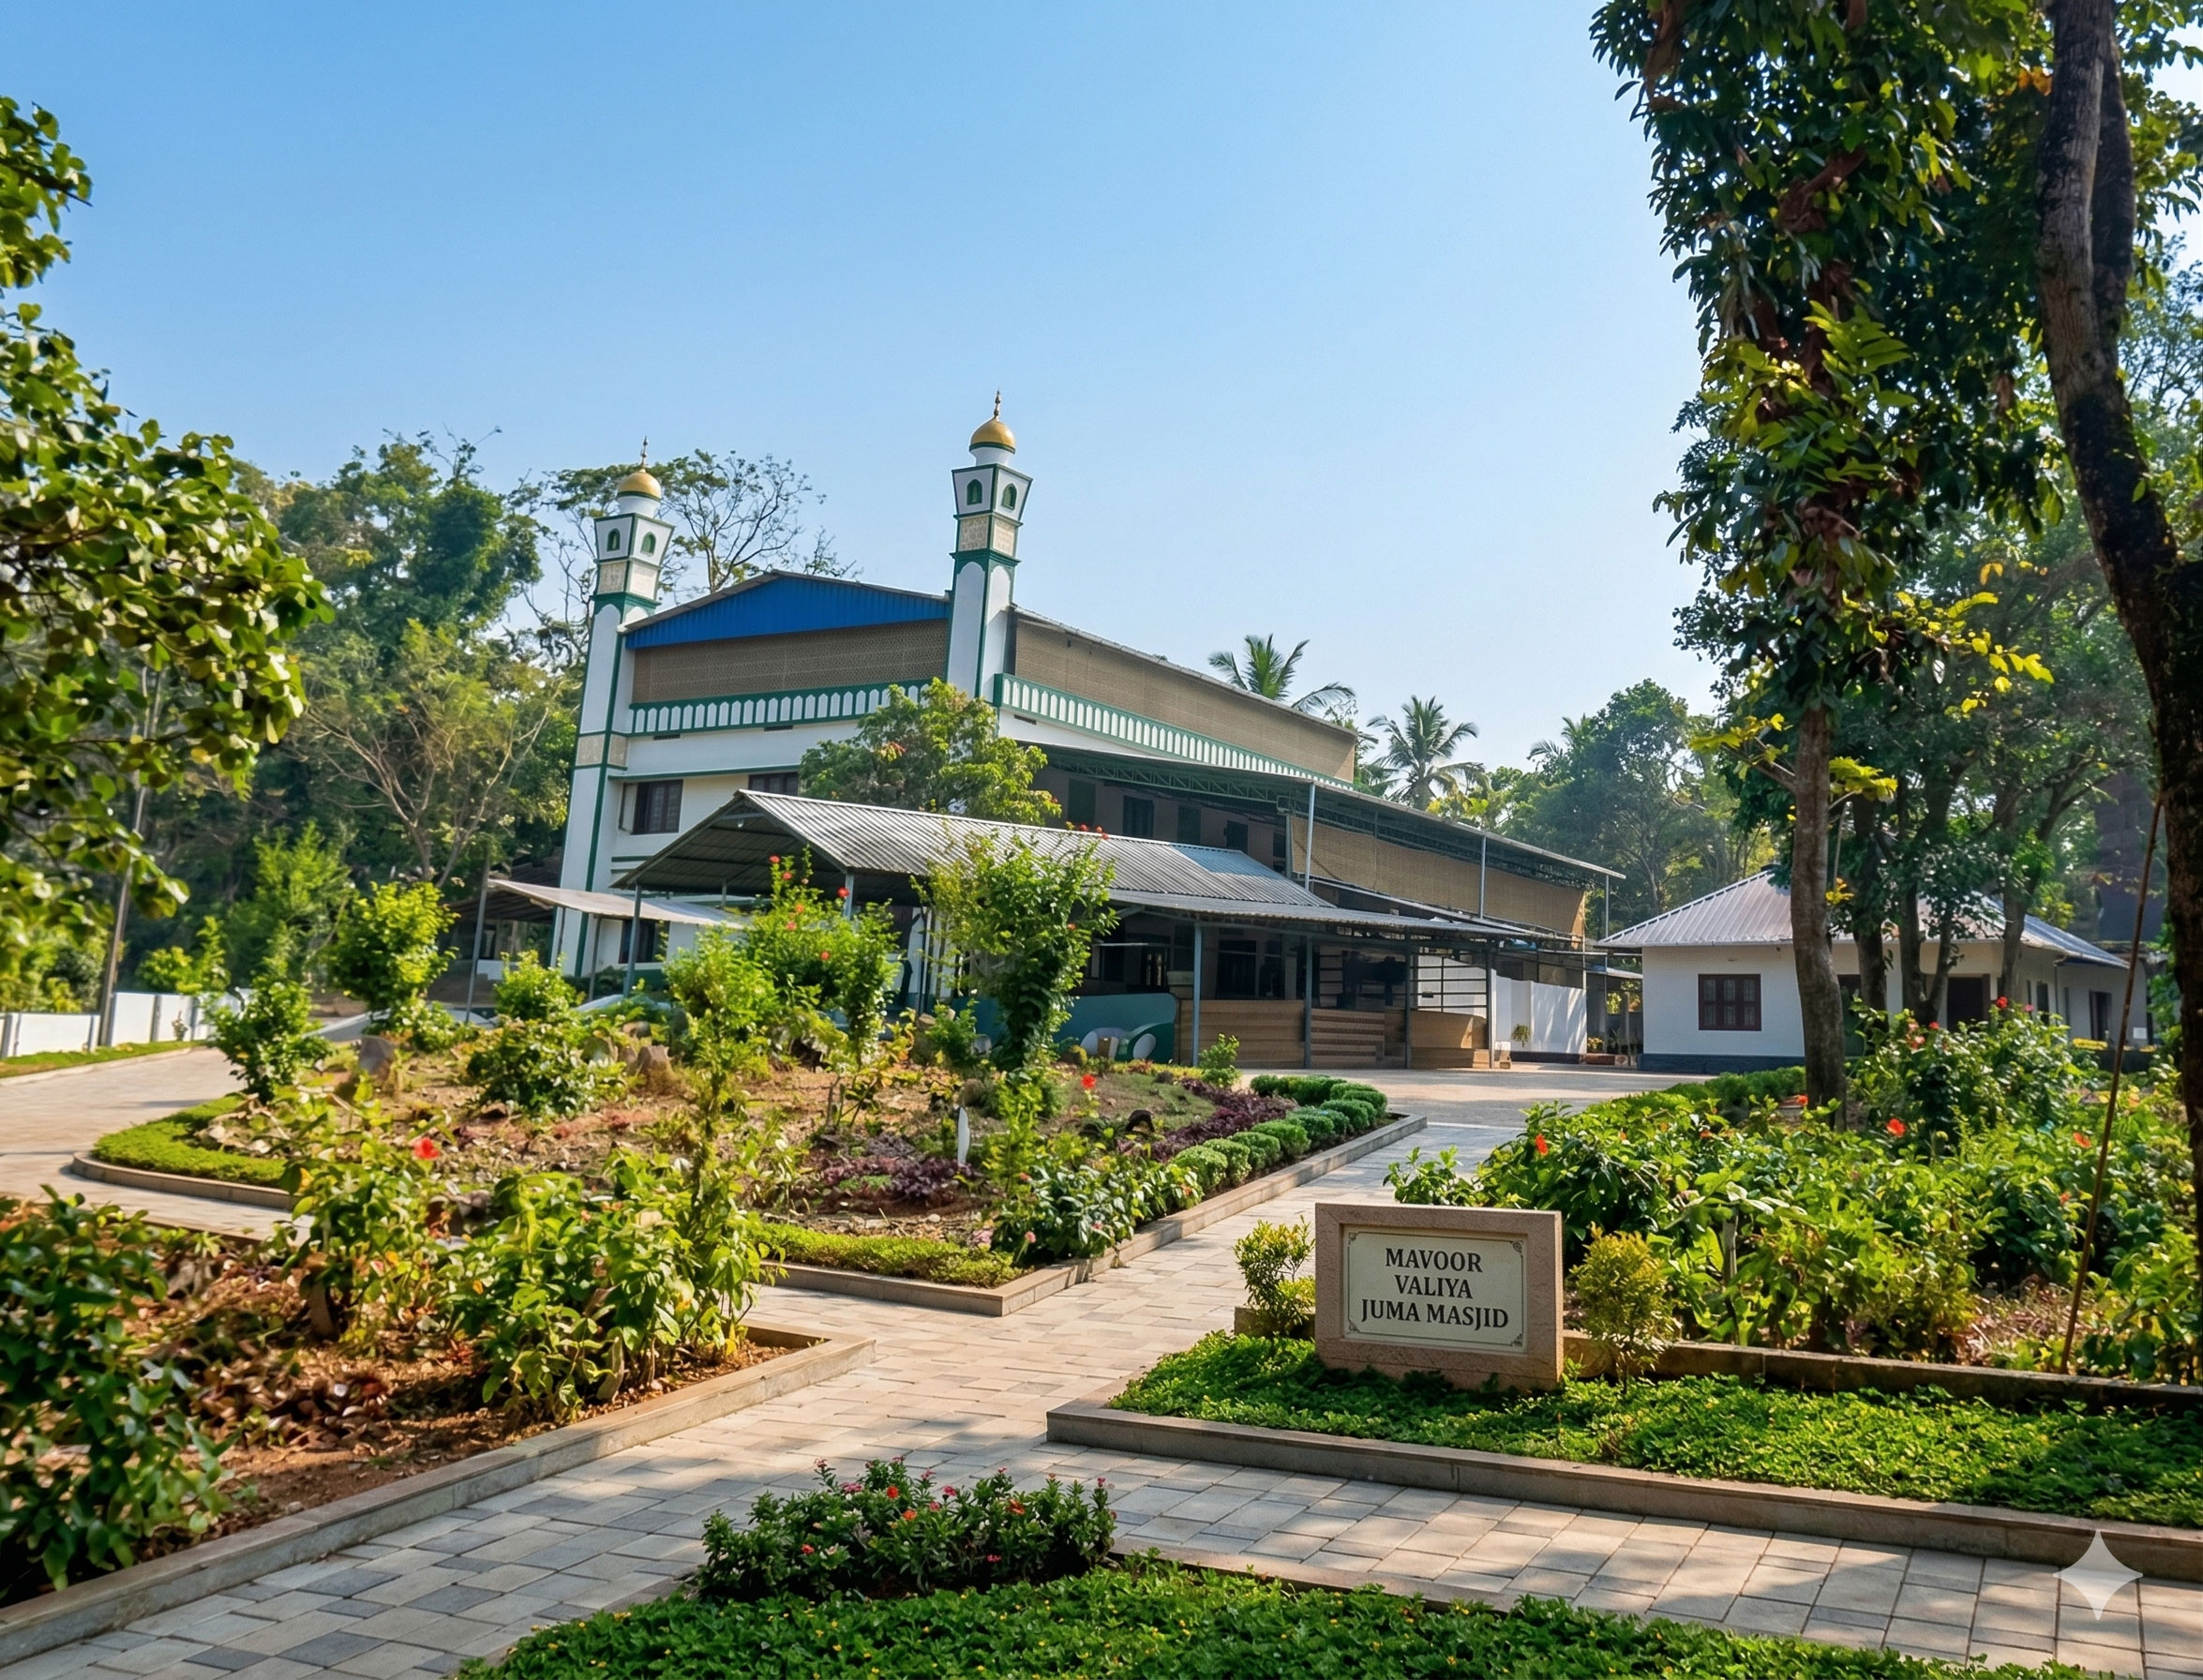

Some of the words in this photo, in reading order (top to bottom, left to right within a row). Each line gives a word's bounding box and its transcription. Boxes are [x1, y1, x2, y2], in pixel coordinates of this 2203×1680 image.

[1385, 1248, 1483, 1273] MAVOOR
[1394, 1274, 1474, 1299] VALIYA
[1361, 1298, 1421, 1322] JUMA
[1426, 1303, 1509, 1331] MASJID
